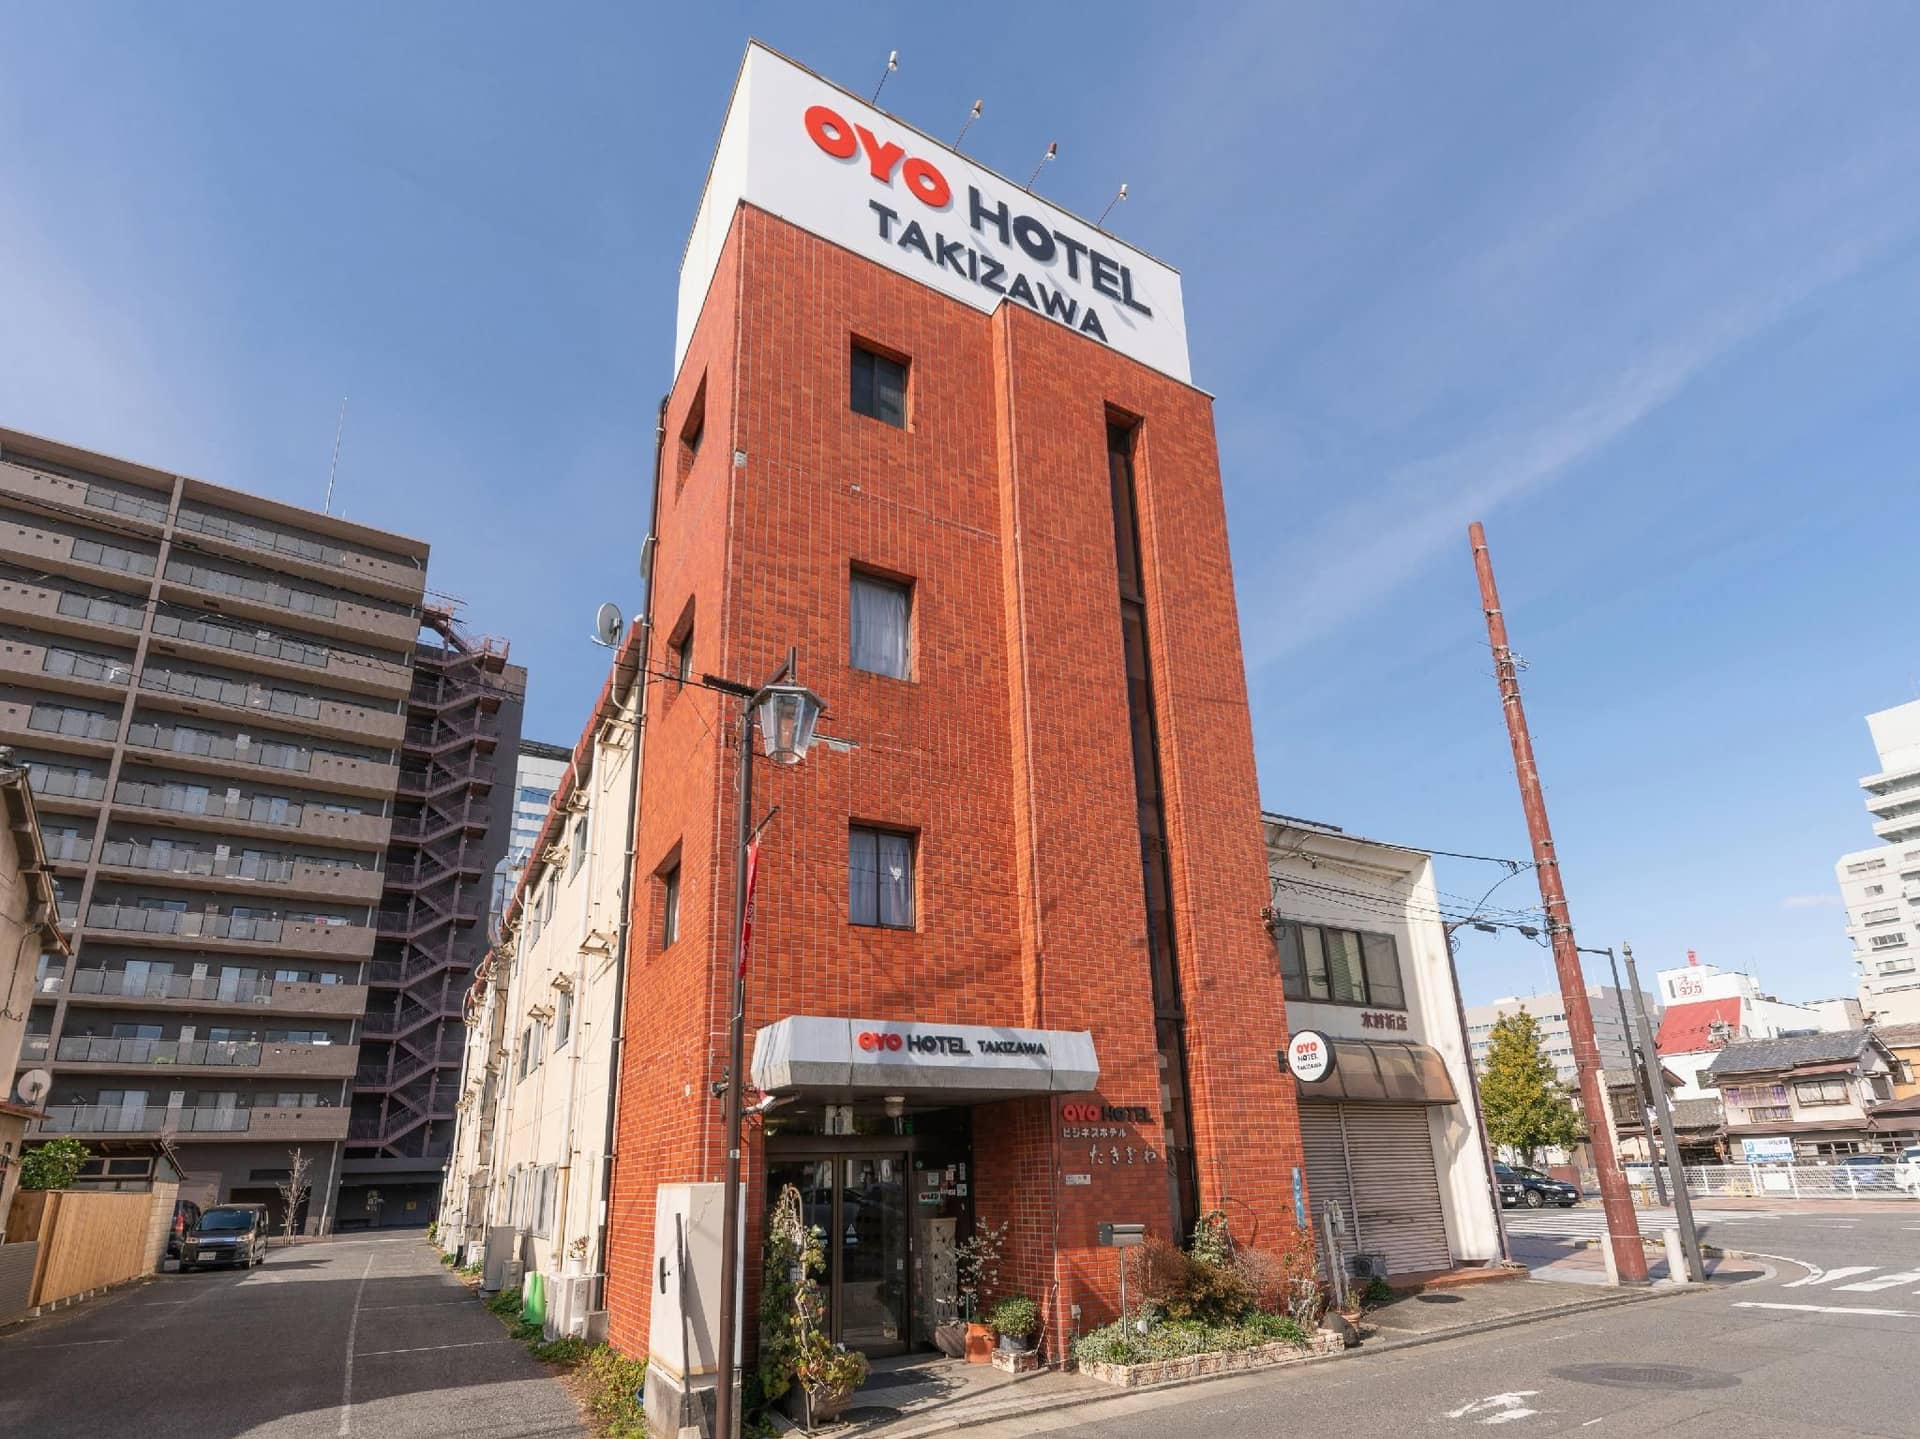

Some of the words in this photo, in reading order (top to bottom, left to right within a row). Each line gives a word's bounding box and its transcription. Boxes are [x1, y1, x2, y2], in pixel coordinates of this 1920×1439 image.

[804, 105, 951, 207] OYO
[969, 185, 1152, 316] HOTEL
[869, 199, 1108, 342] TAKIZAWA
[858, 1032, 903, 1051] OYO
[907, 1035, 970, 1054] HOTEL
[977, 1039, 1047, 1056] TAKIZAWA
[1296, 1041, 1317, 1054] OYO
[1063, 1104, 1099, 1121] OYO
[1102, 1105, 1155, 1123] HOTEL
[1063, 1127, 1127, 1138] ビジネスホテル
[1089, 1143, 1157, 1165] たきざわ
